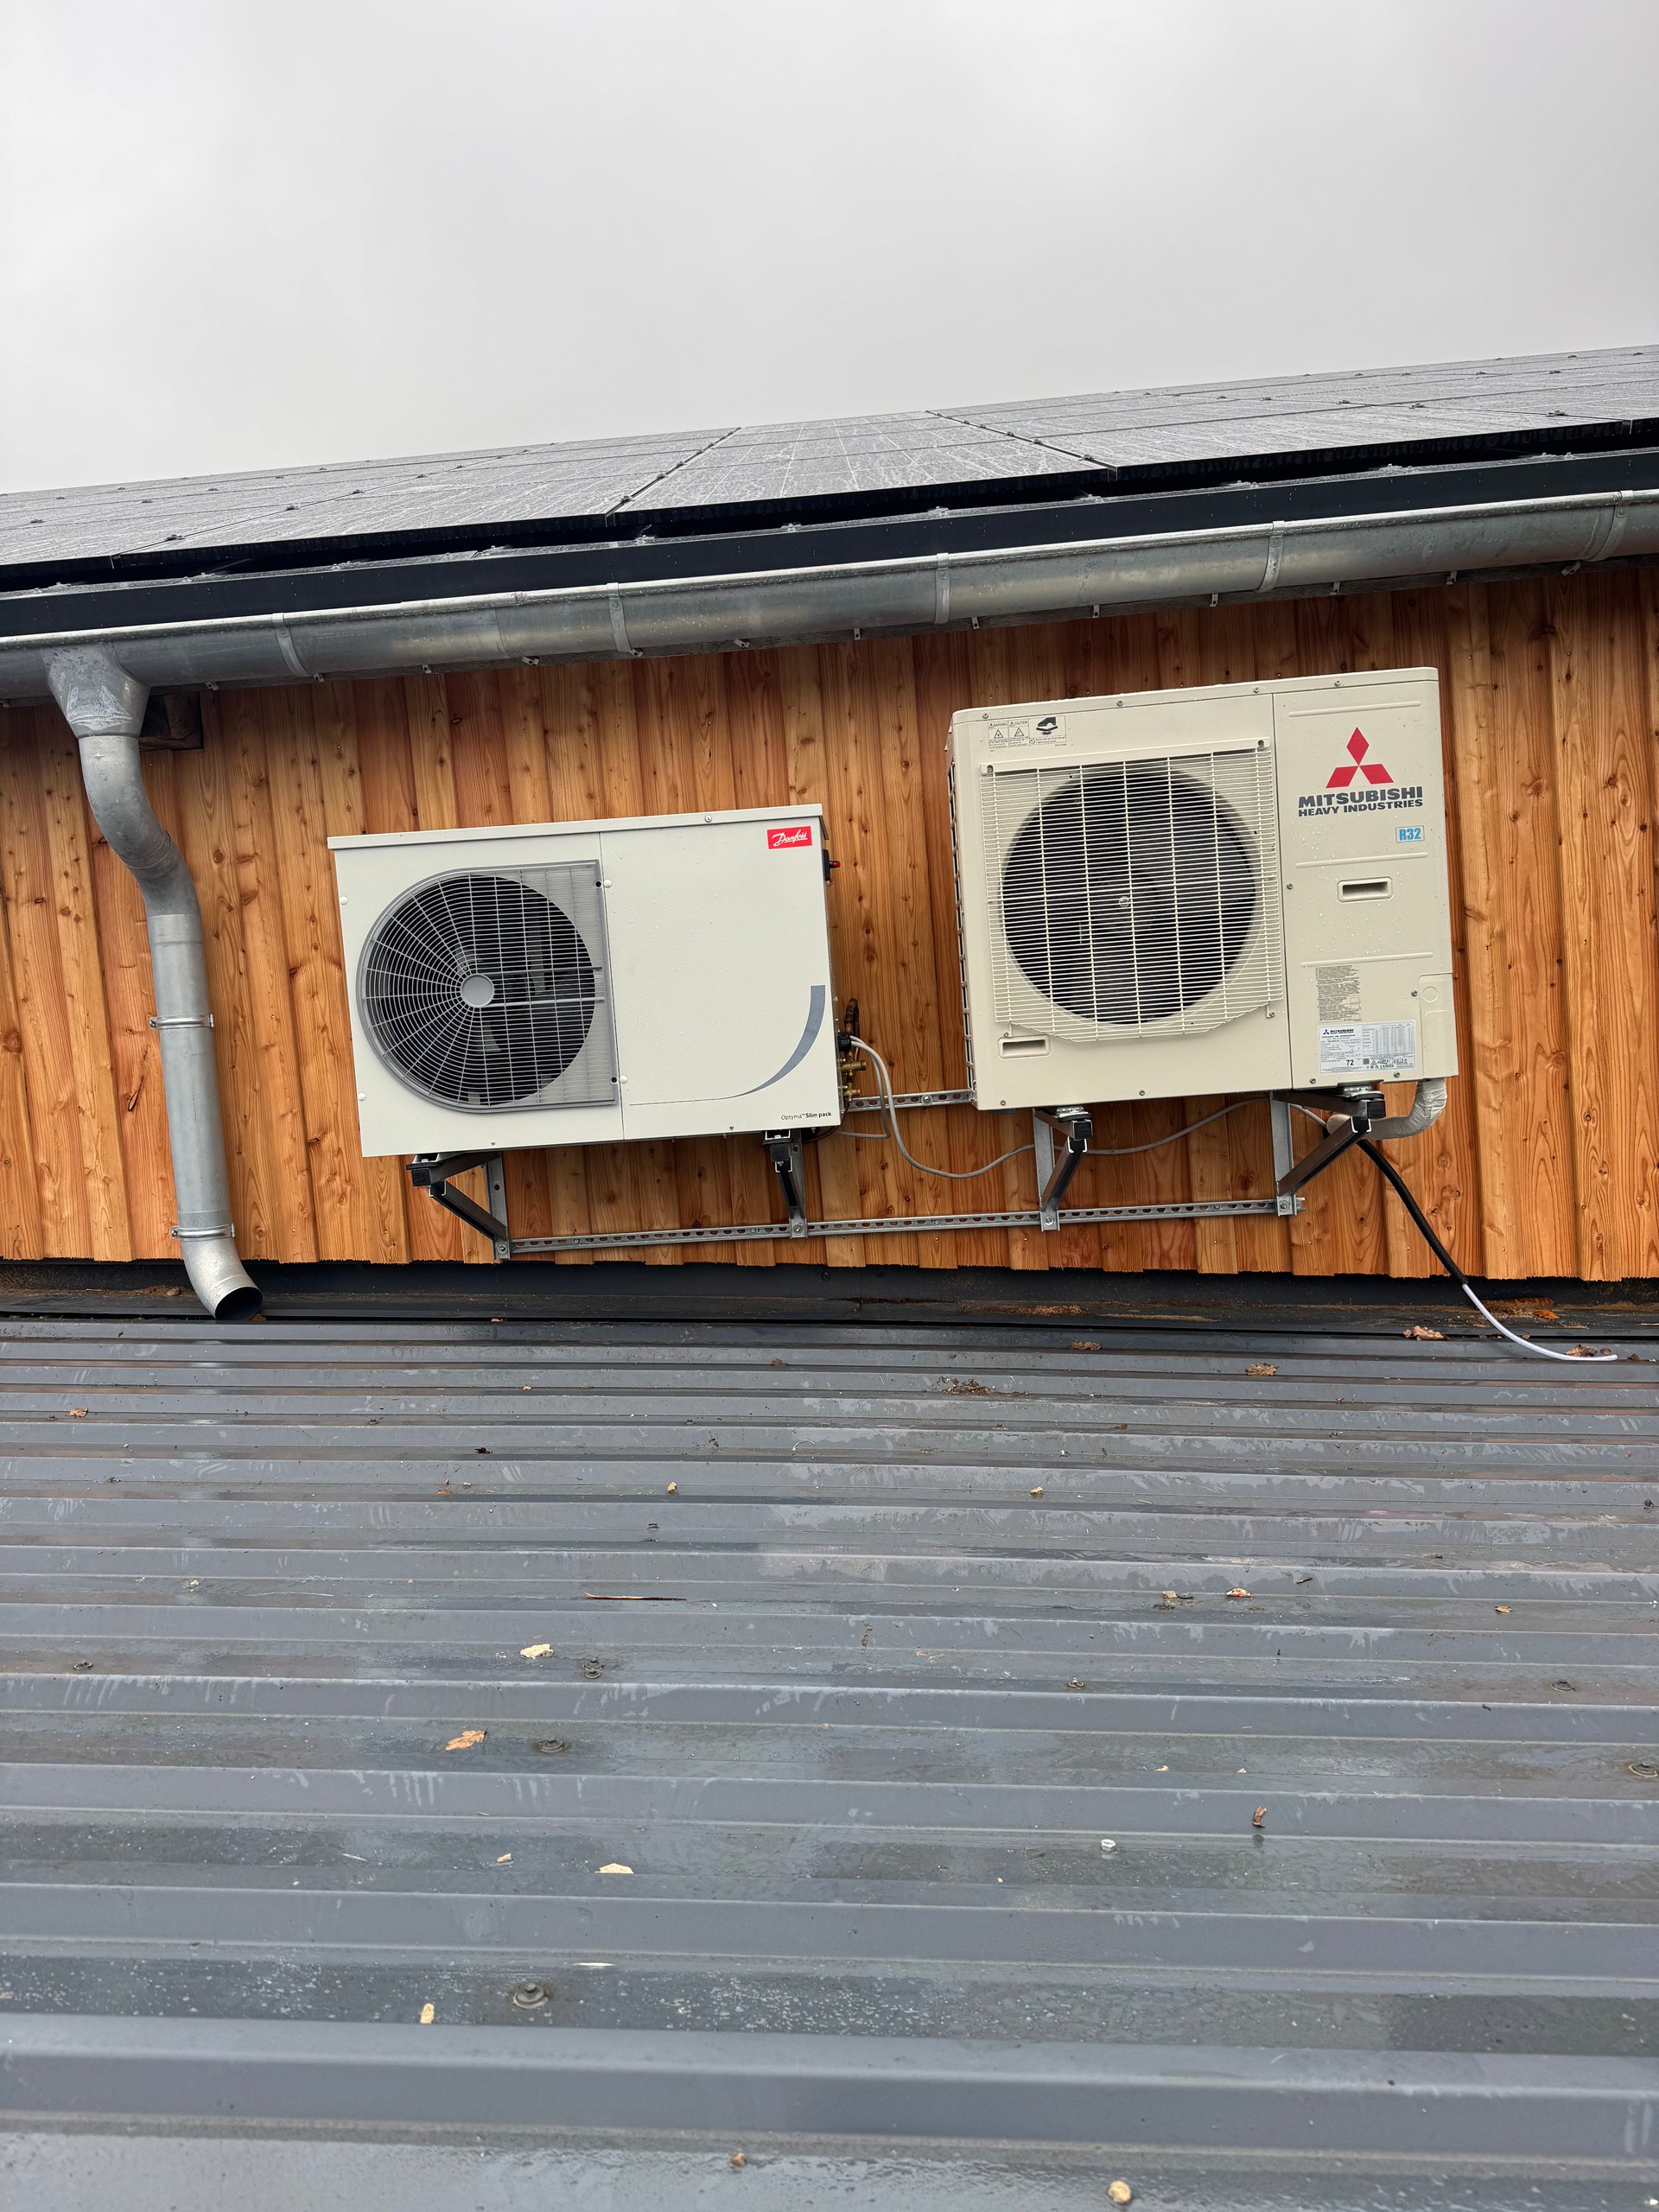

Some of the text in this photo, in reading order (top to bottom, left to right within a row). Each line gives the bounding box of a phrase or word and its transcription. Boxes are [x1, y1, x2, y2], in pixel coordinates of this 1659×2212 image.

[1298, 786, 1423, 808] MITSUBISHI
[1298, 799, 1423, 817] HEAVY INDUSTRIES
[772, 830, 809, 847] Danfoss
[1399, 828, 1421, 841] R32
